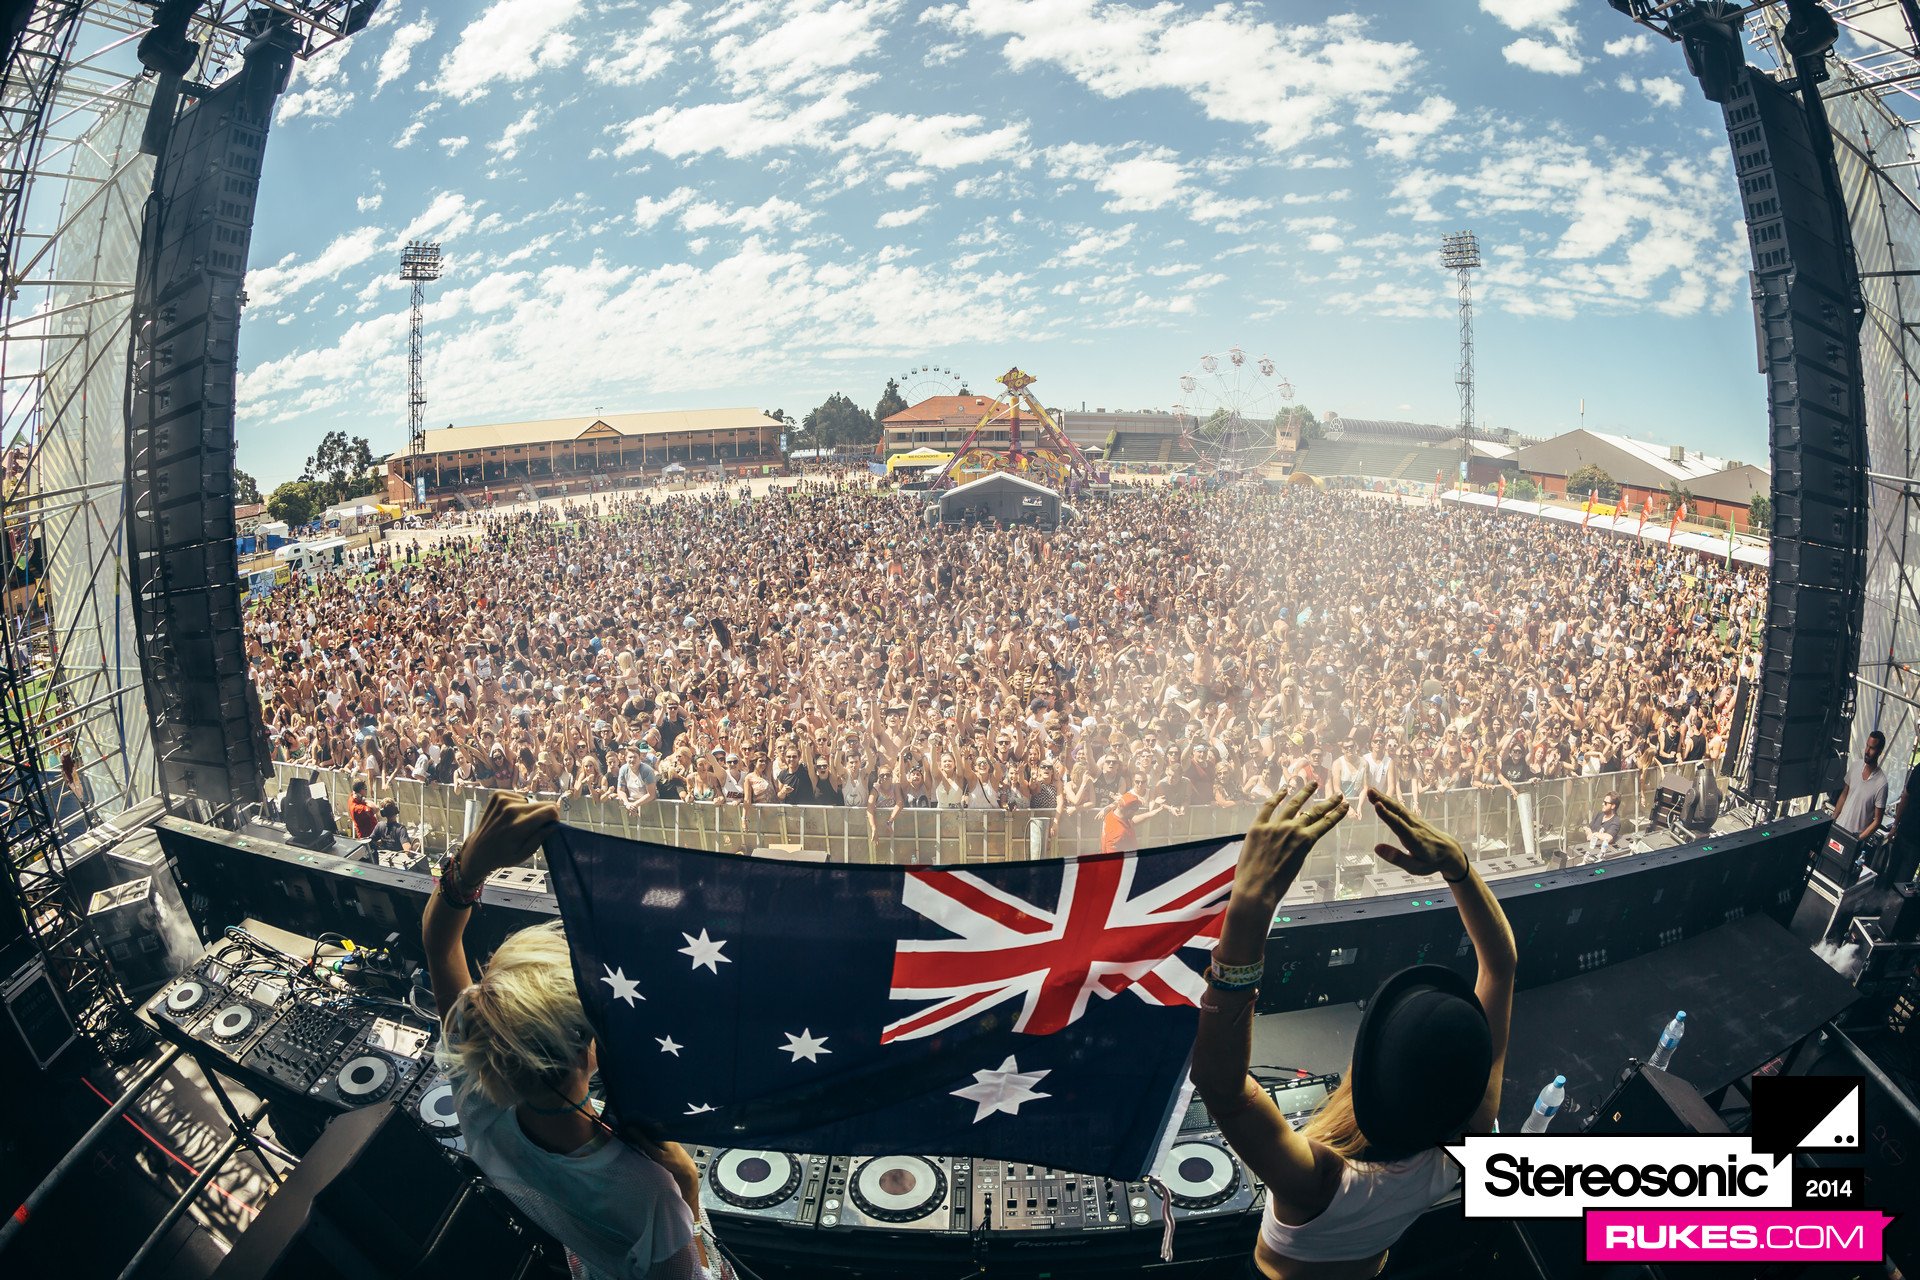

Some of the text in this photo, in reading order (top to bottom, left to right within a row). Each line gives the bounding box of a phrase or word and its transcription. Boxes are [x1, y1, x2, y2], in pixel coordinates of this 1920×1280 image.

[996, 370, 1025, 383] HARD
[1008, 376, 1037, 390] ROCK
[1188, 1208, 1221, 1216] Pioneer
[1013, 1239, 1091, 1248] Pioneer
